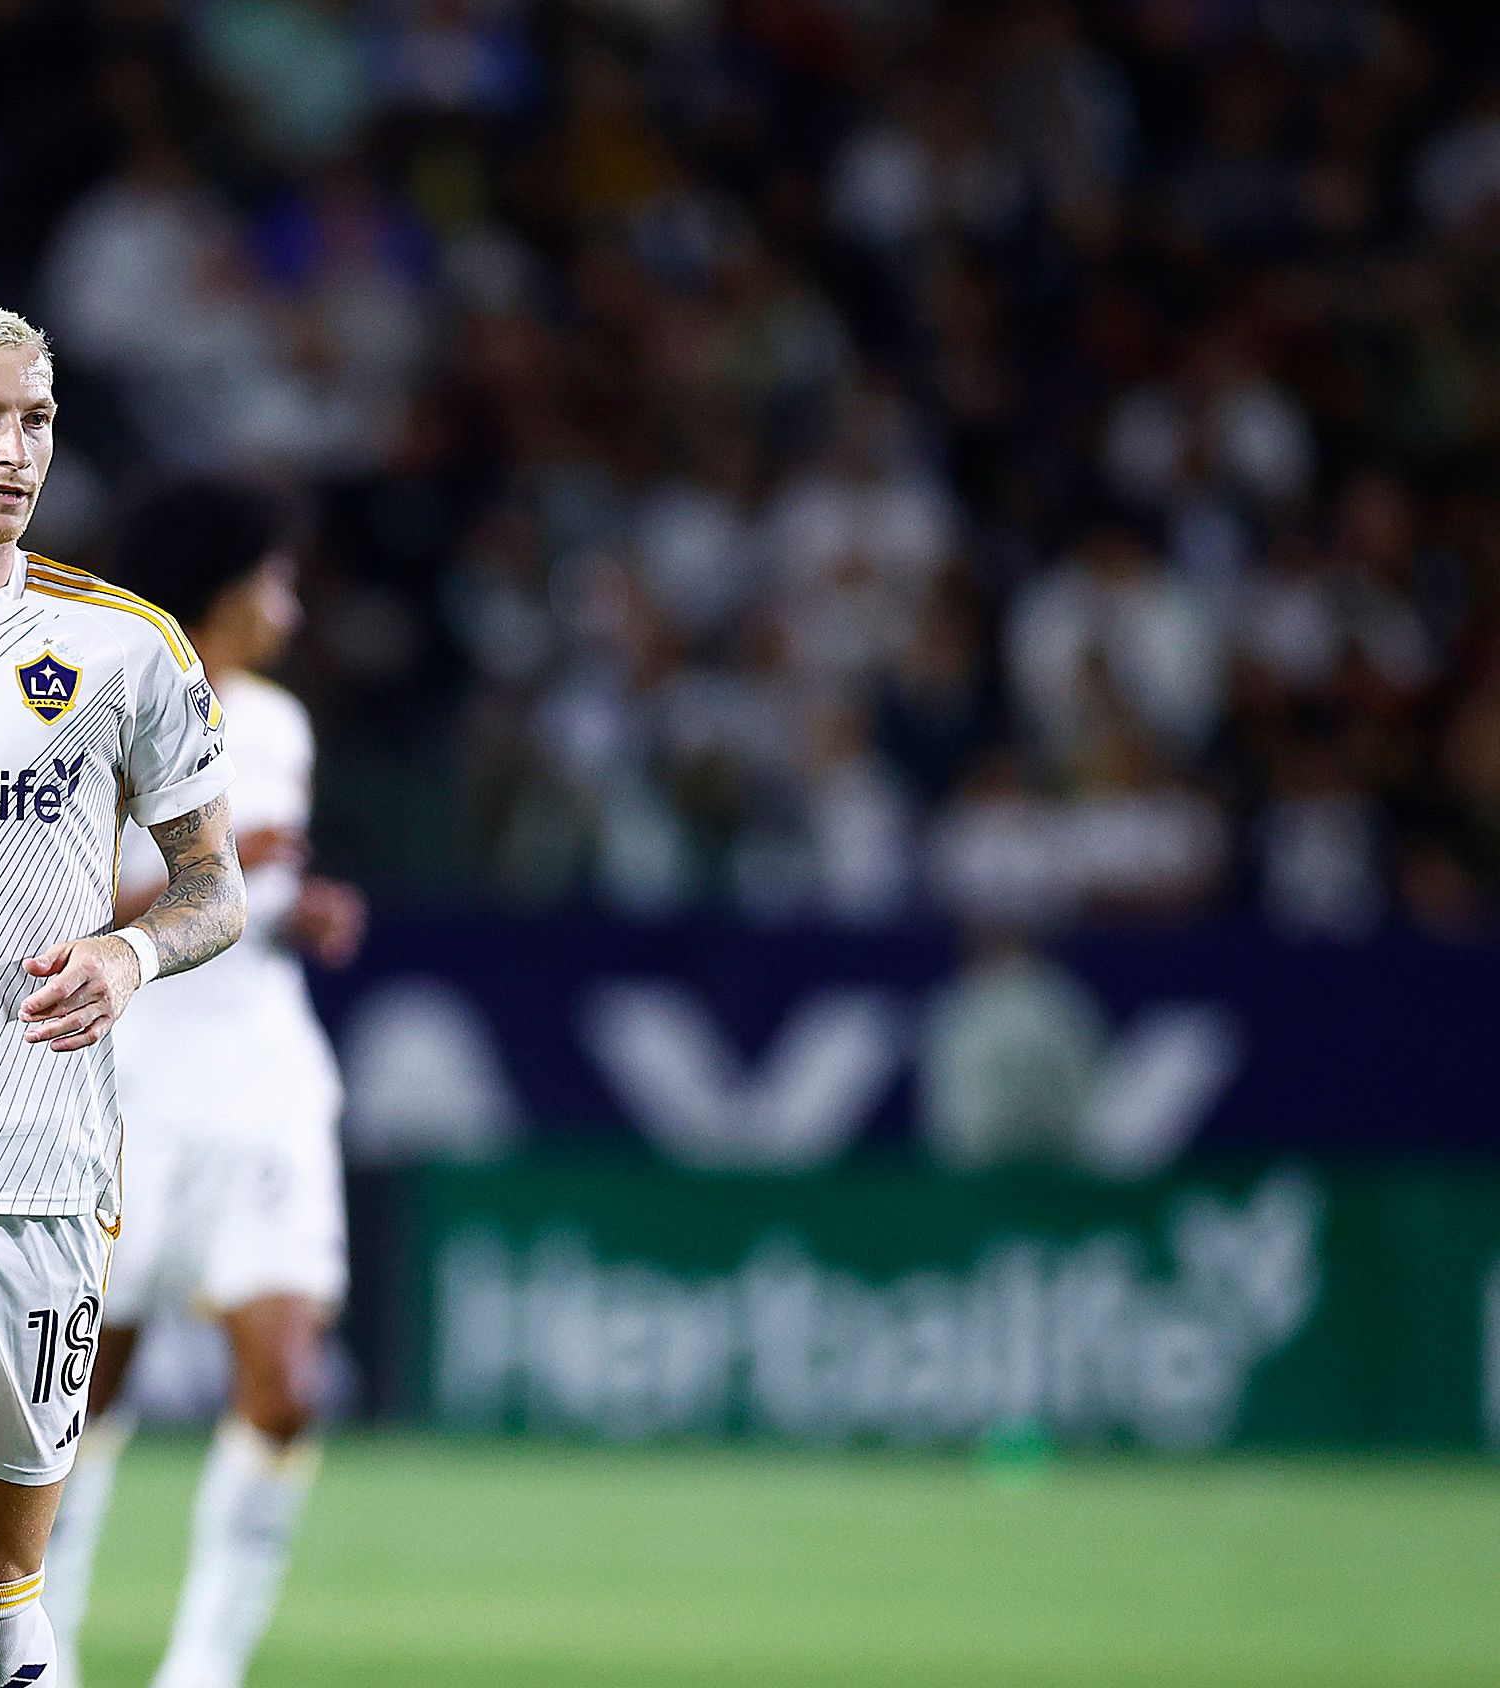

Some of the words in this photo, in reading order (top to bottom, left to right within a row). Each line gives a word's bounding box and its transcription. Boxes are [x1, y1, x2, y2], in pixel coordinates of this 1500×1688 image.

[30, 676, 68, 697] LA
[28, 699, 69, 708] GALAXY
[27, 1295, 99, 1404] 18
